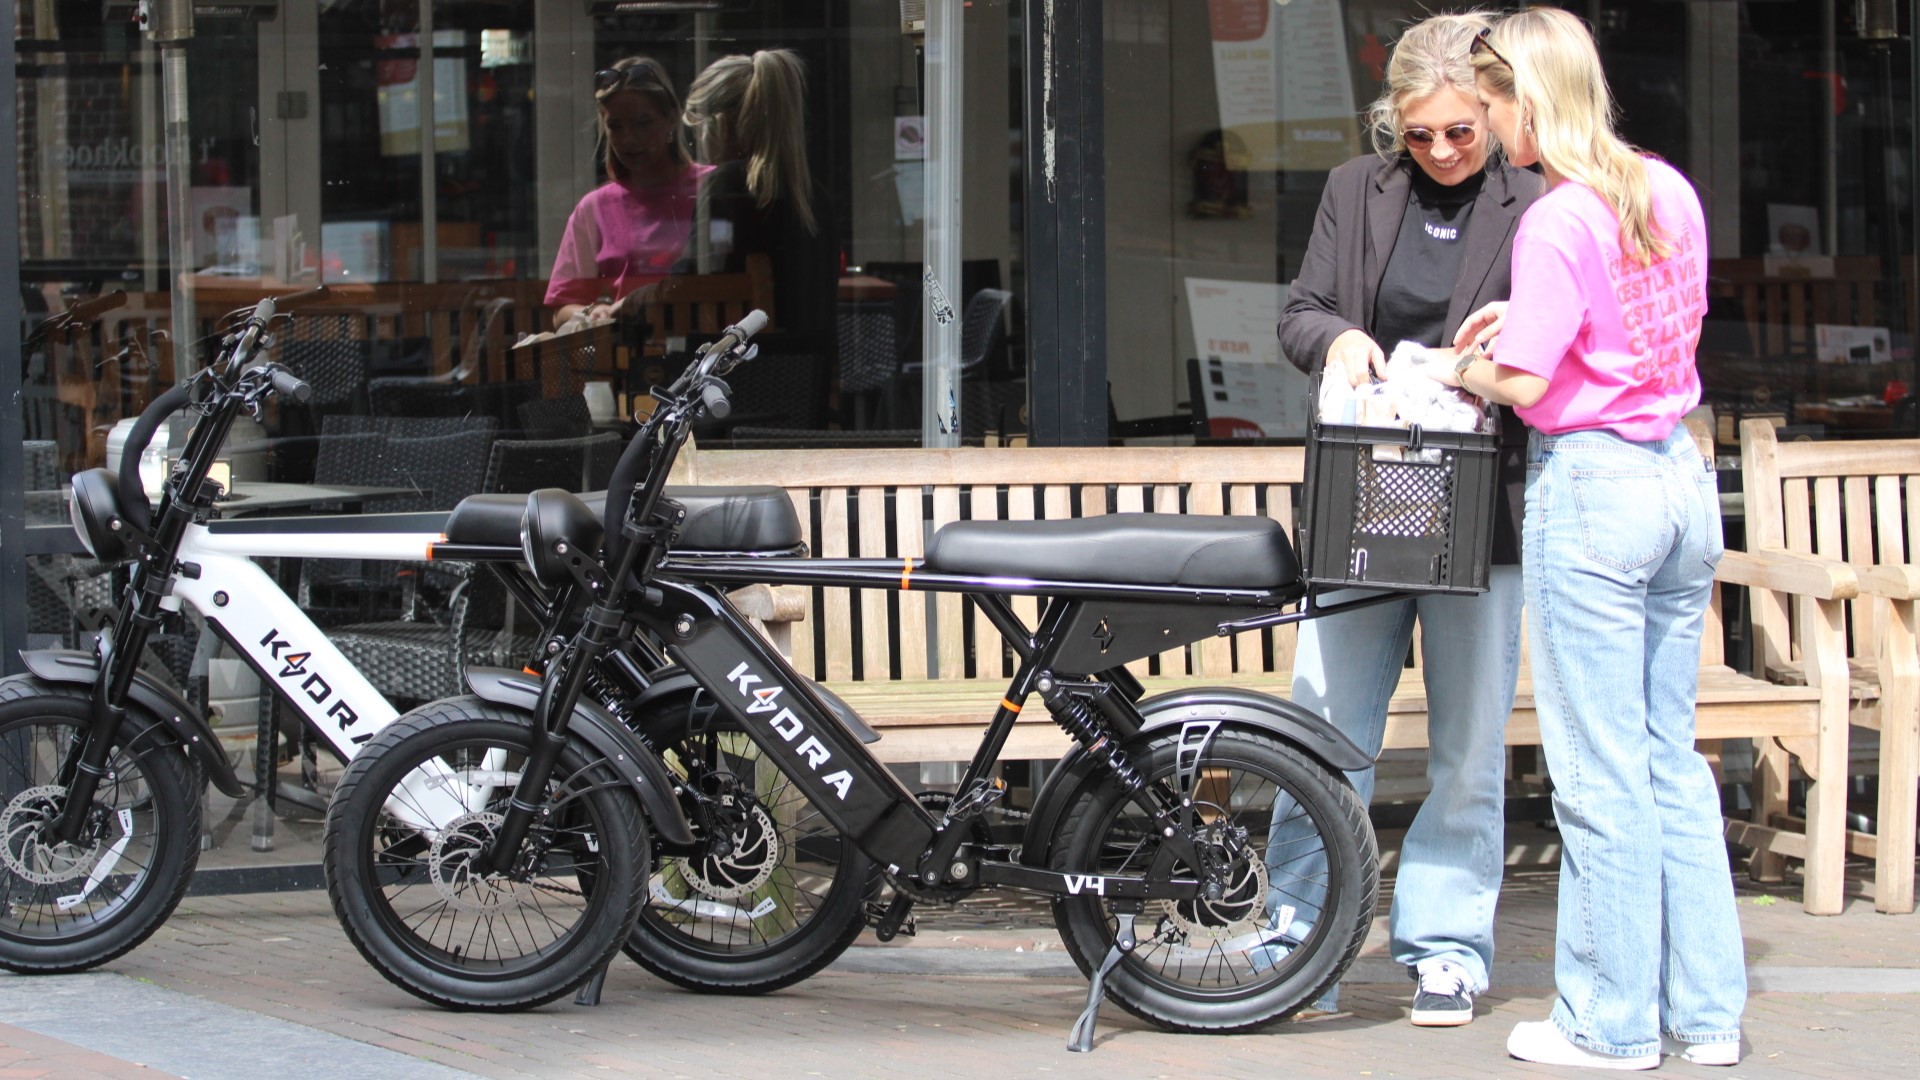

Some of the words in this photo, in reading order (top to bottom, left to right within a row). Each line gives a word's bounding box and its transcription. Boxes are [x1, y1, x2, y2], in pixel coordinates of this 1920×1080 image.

[1424, 222, 1457, 240] ICONIC
[1652, 268, 1675, 293] LA
[1677, 257, 1698, 283] VIE
[1658, 294, 1677, 319] LA
[1680, 282, 1701, 308] VIE
[1660, 319, 1681, 345] LA
[1658, 345, 1680, 368] LA
[1063, 874, 1105, 896] V4
